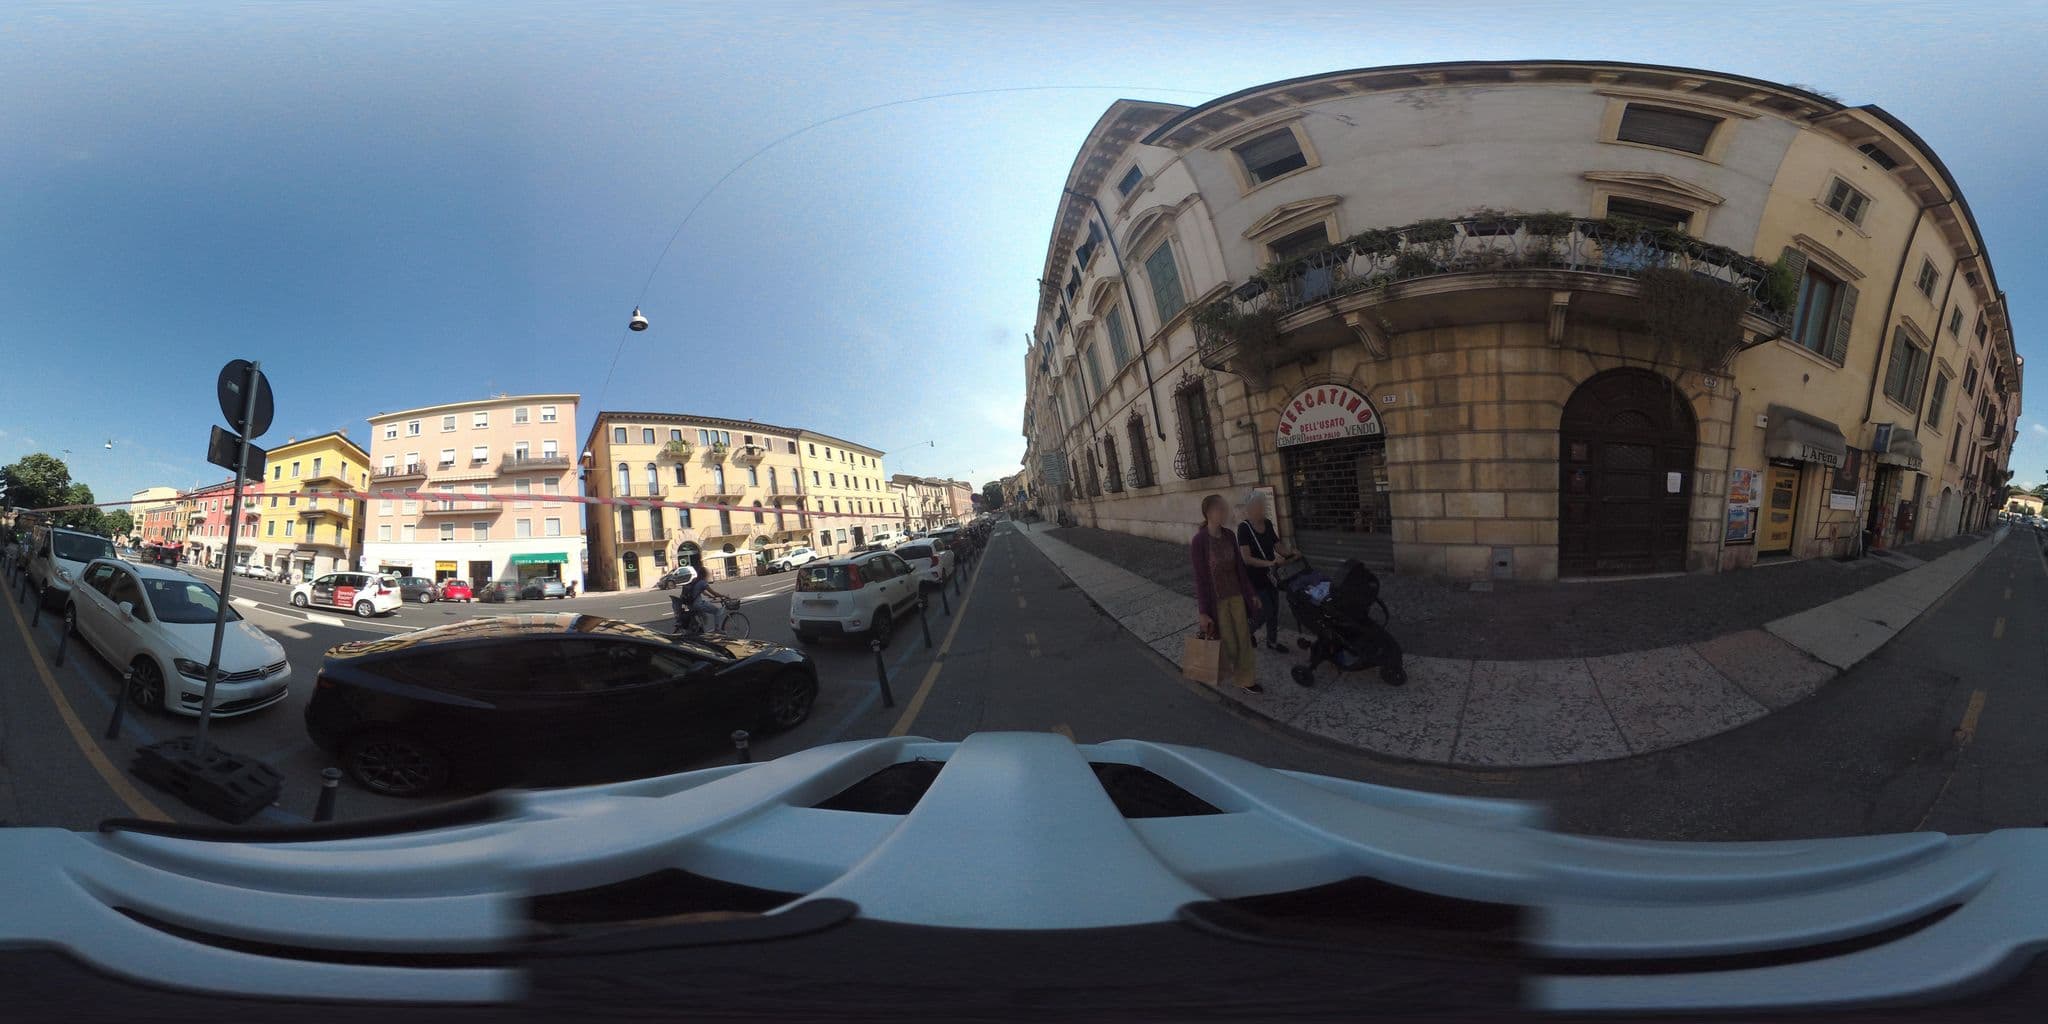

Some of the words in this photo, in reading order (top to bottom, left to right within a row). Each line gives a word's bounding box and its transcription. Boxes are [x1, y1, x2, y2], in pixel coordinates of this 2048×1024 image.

[1280, 388, 1372, 435] MERCATINO
[1300, 417, 1345, 432] DELL'USATO
[1345, 422, 1376, 436] VENDO
